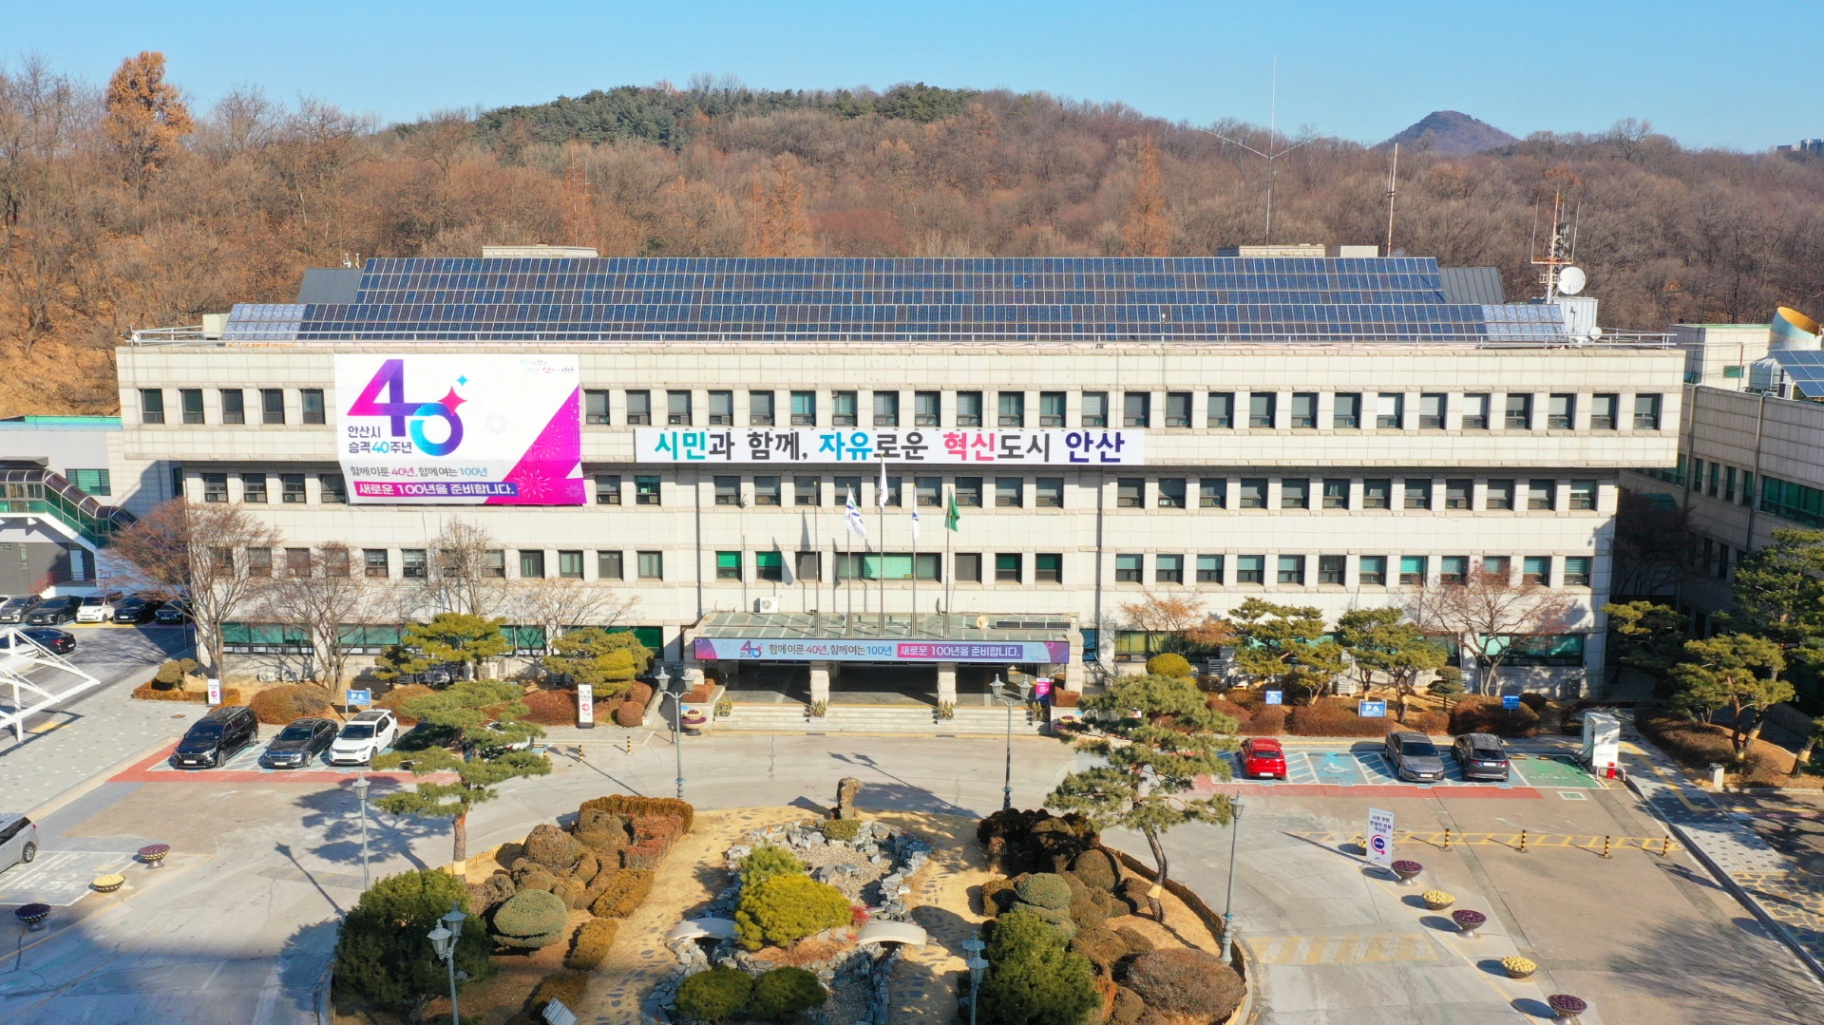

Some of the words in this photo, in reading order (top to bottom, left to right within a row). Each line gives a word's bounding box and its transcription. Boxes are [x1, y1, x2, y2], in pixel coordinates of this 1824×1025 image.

[347, 426, 381, 439] 안산시
[654, 431, 735, 461] 시민과
[747, 431, 808, 461] 함께,
[818, 431, 929, 461] 자유로운
[943, 431, 1050, 463] 혁신도시
[1065, 431, 1125, 463] 안산
[391, 467, 418, 477] 40년,
[459, 467, 488, 477] 100년
[359, 483, 395, 495] 새로운
[397, 483, 448, 495] 100년을
[450, 483, 515, 495] 준비합니다.
[866, 645, 892, 656] 100년
[900, 645, 928, 656] 새로운
[931, 646, 969, 657] 100년을
[971, 646, 1020, 657] 준비합니다.
